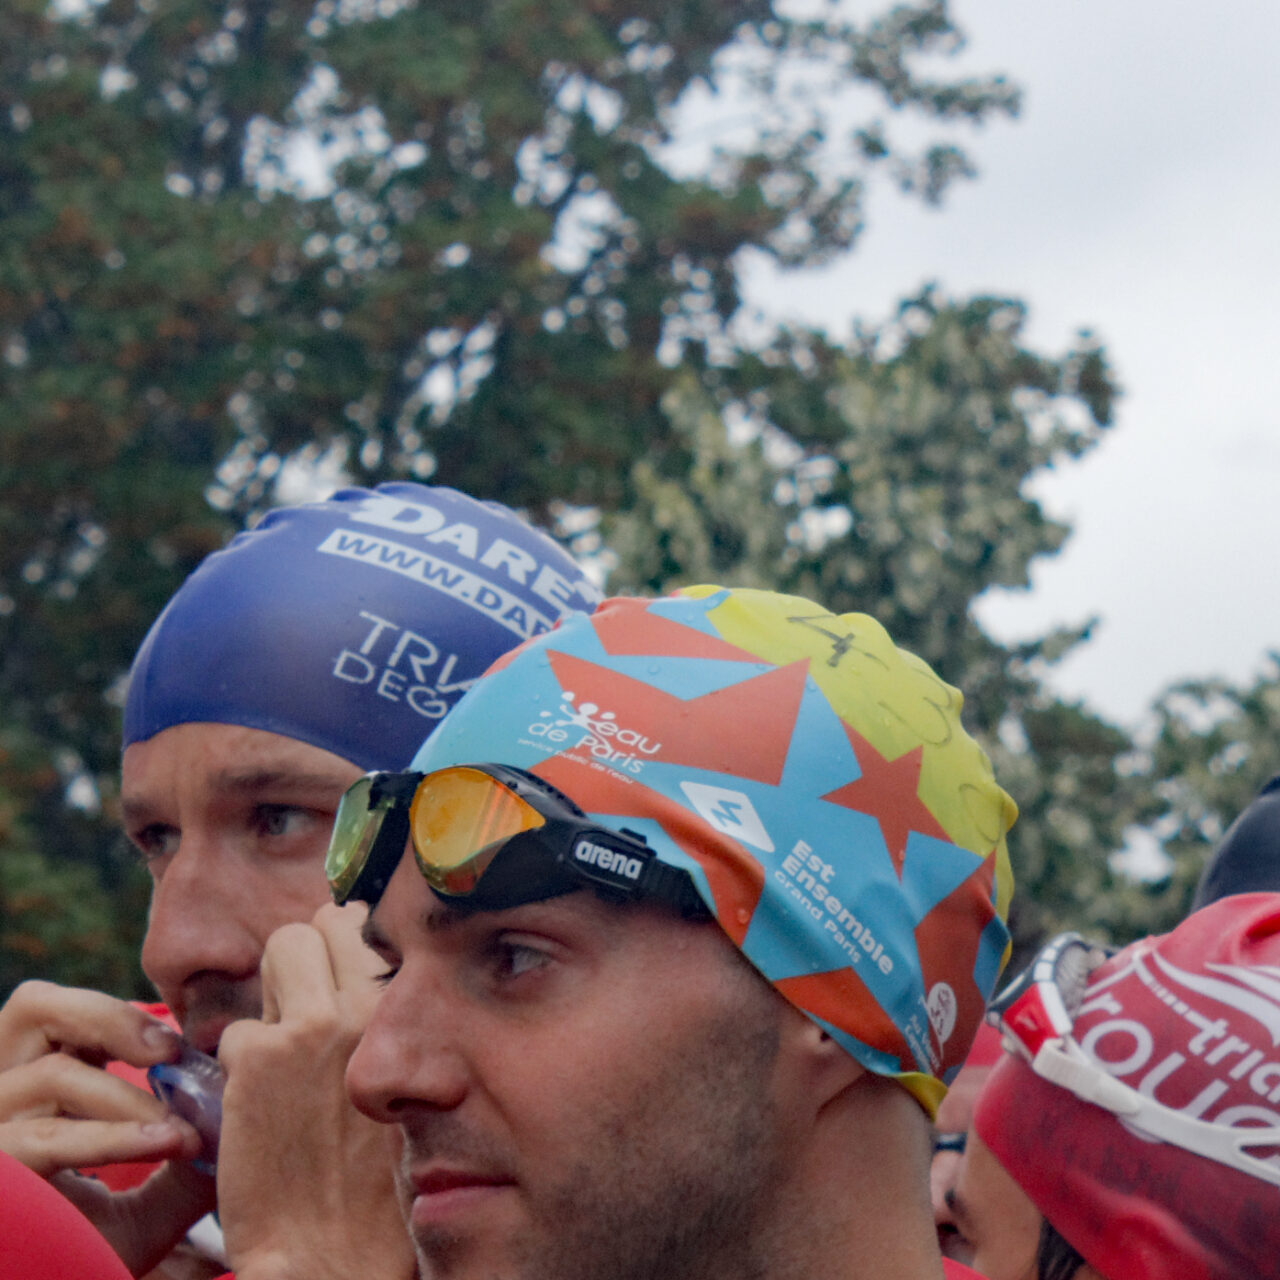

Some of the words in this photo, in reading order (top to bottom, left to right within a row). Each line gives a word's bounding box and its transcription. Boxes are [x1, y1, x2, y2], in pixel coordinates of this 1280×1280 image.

[350, 497, 606, 622] DARE
[528, 722, 568, 742] de
[575, 735, 645, 773] Paris
[575, 840, 643, 880] arena
[792, 839, 835, 883] Est
[774, 870, 824, 920] Grand
[824, 919, 861, 963] Paris
[782, 854, 893, 975] Ensemble
